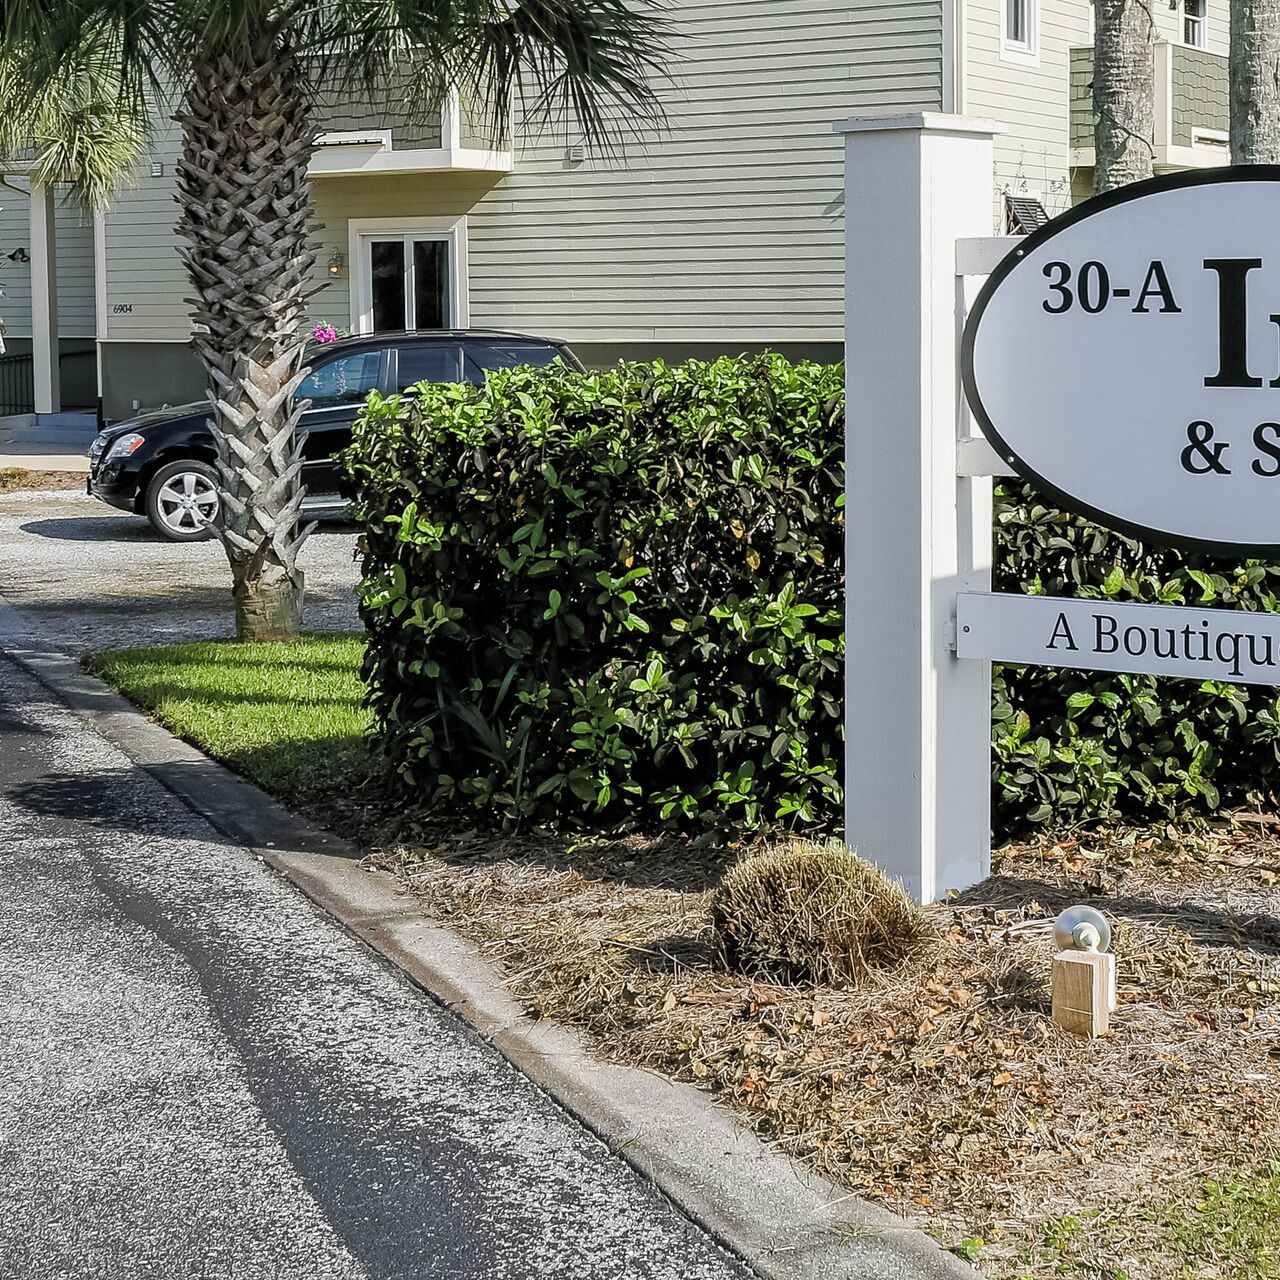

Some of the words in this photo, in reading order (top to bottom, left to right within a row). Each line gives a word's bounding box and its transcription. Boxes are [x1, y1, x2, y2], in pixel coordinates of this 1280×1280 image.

[113, 304, 133, 313] 6904
[1041, 259, 1182, 315] 30-A
[1180, 419, 1232, 476] &
[1046, 613, 1079, 652] A
